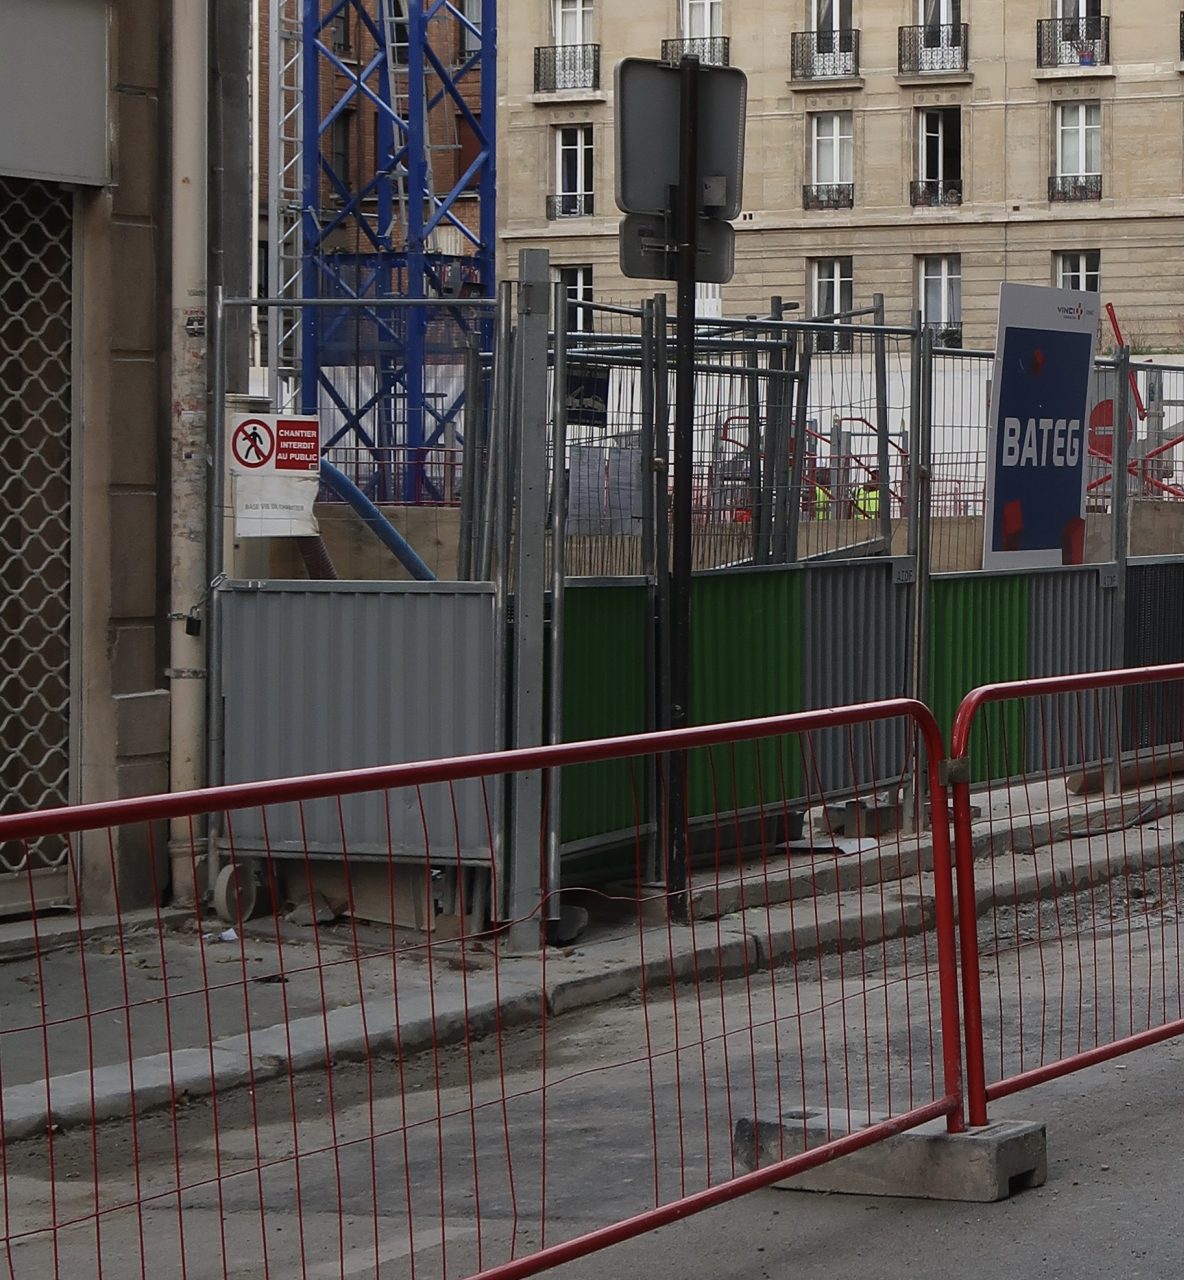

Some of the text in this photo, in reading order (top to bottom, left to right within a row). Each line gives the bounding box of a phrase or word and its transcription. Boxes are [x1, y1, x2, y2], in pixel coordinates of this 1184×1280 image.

[1057, 306, 1076, 315] VINCI
[278, 429, 317, 438] CHANTIER
[280, 441, 316, 450] INTERDIT
[1002, 417, 1081, 467] BATEG
[289, 453, 318, 461] PUBLIC
